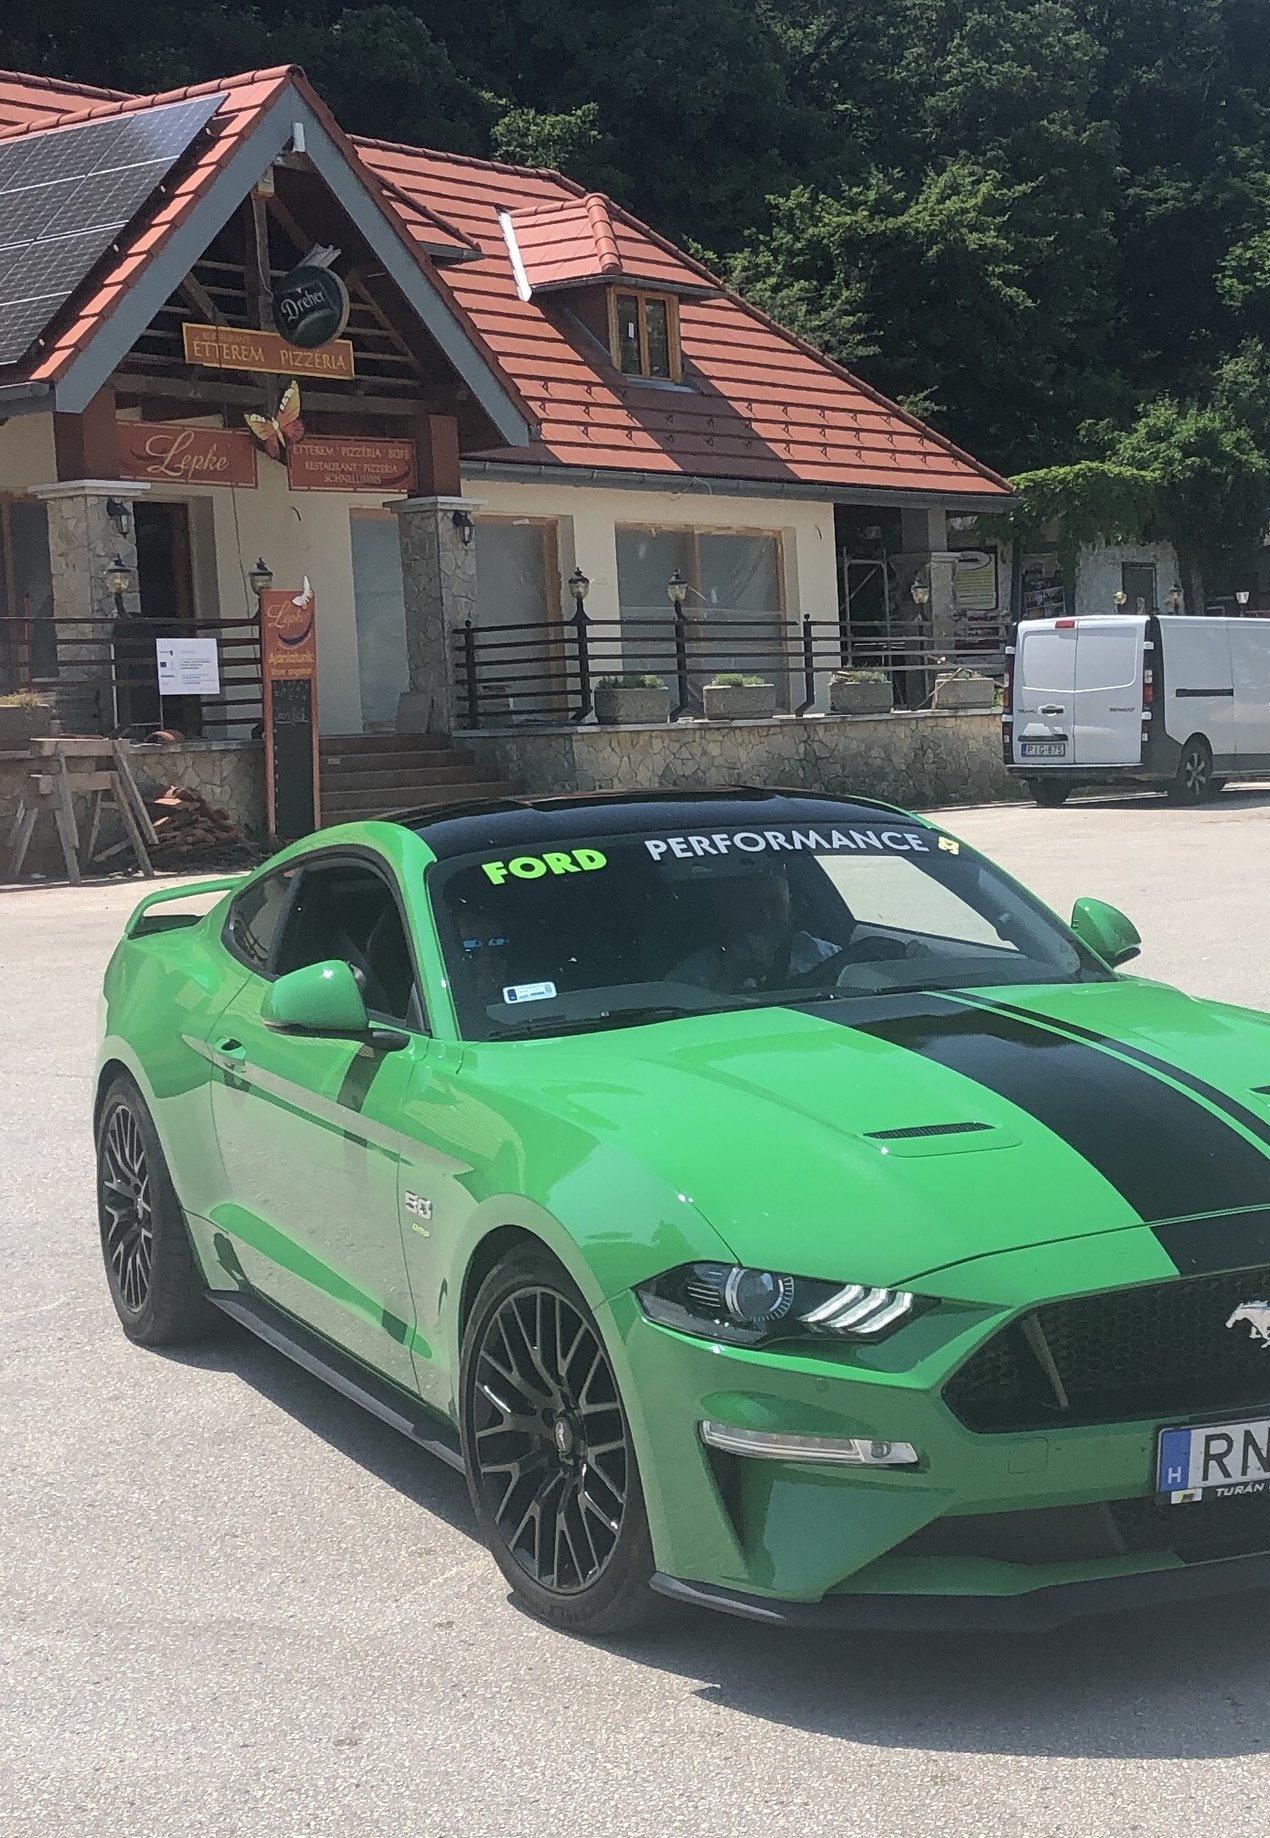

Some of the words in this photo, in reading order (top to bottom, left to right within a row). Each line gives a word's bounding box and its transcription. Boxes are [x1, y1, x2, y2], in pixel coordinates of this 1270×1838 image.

[281, 291, 326, 322] Dreher
[145, 430, 230, 479] Lepke
[481, 849, 607, 885] FORD
[644, 829, 930, 861] PERFORMANCE
[1167, 1466, 1182, 1485] H
[1215, 1478, 1264, 1497] TURÁN
